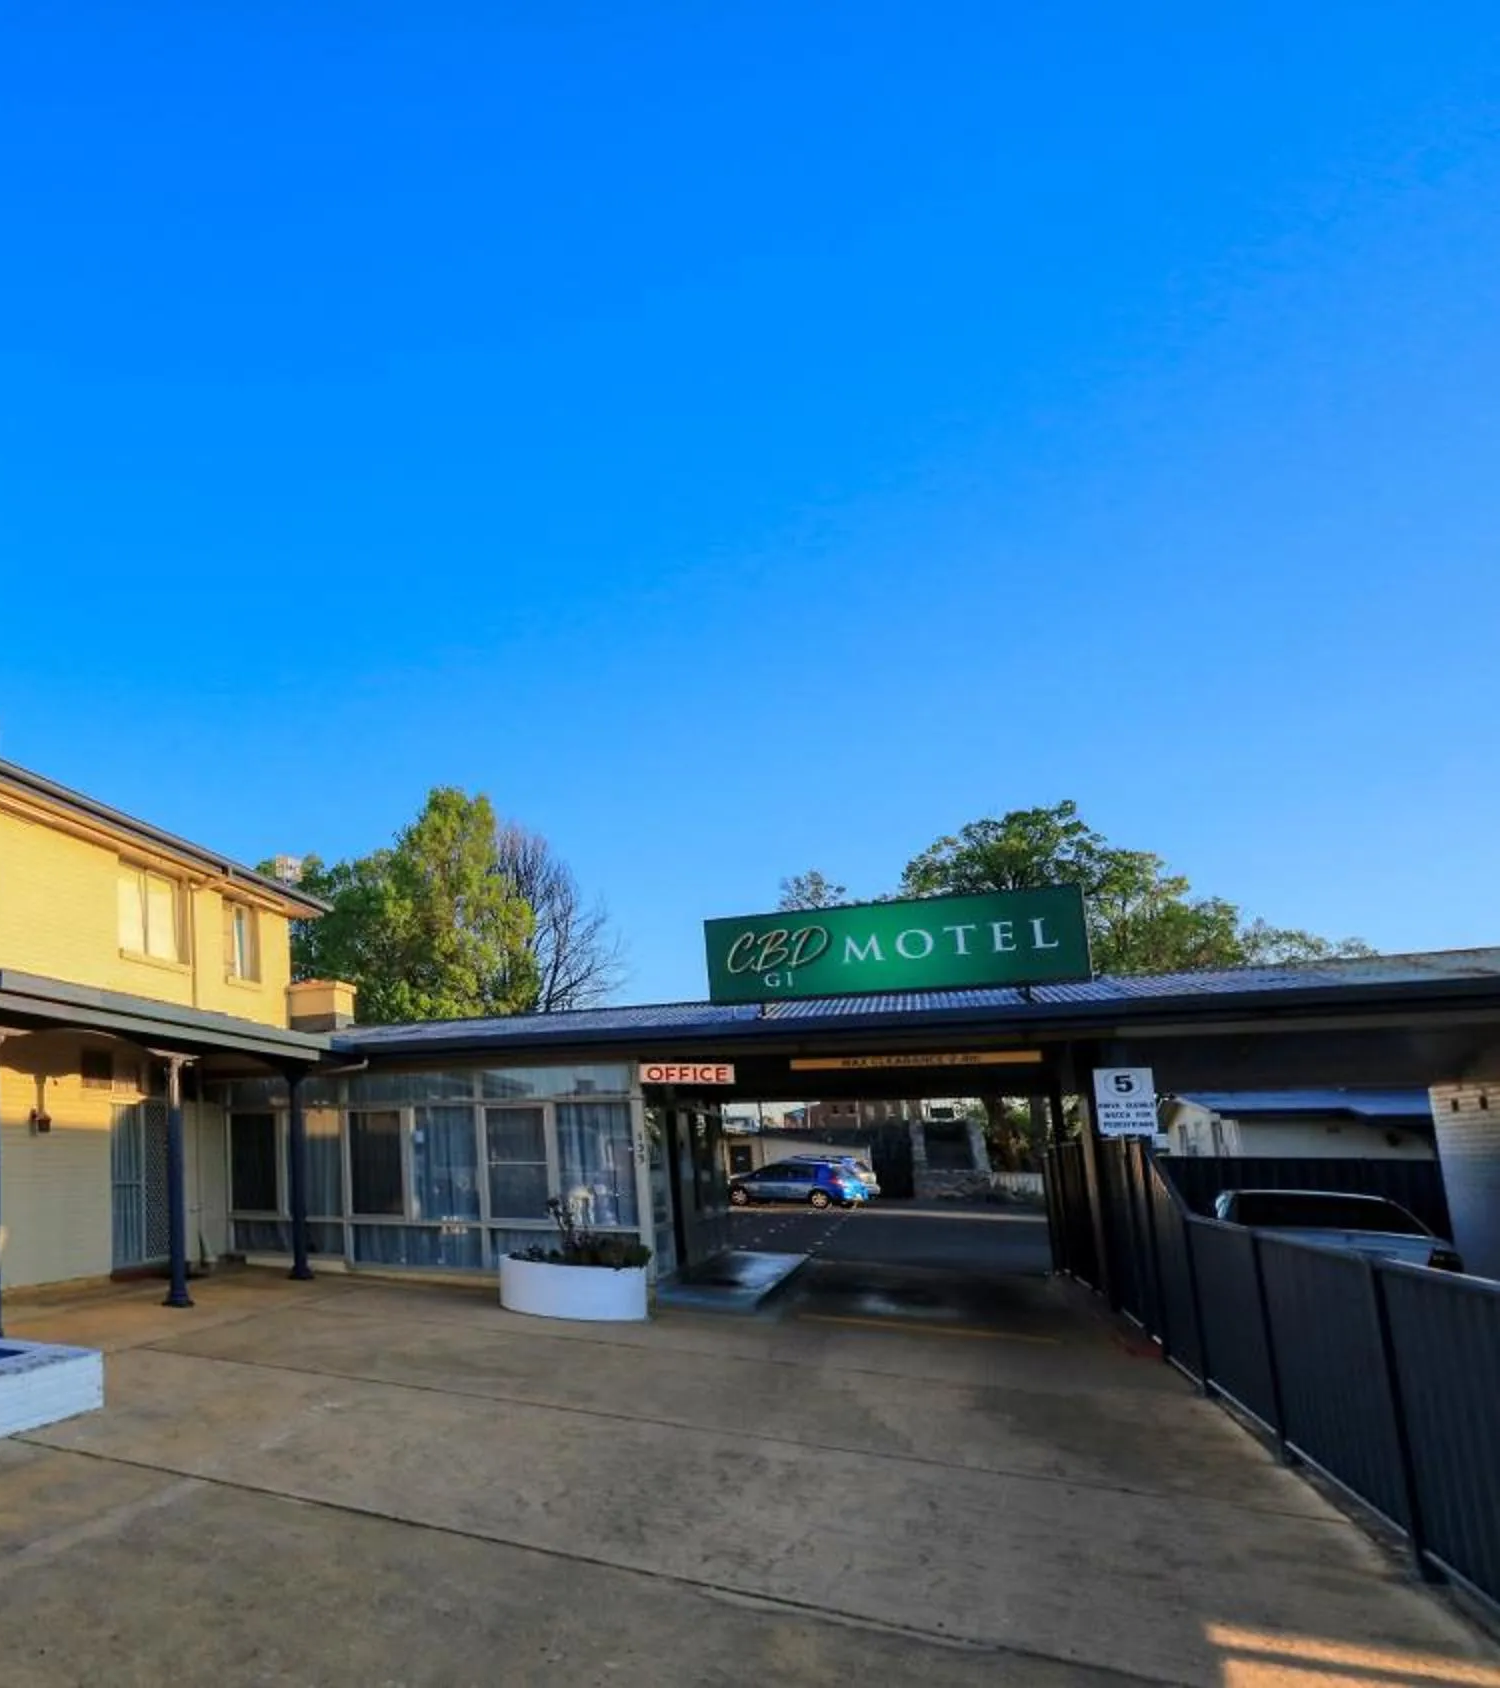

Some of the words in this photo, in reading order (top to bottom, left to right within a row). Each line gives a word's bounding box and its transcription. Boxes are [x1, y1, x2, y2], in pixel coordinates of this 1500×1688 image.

[727, 926, 828, 973] CBD
[842, 917, 1059, 963] MOTEL
[764, 972, 793, 987] GI
[647, 1067, 727, 1081] OFFICE
[1114, 1075, 1133, 1093] 5
